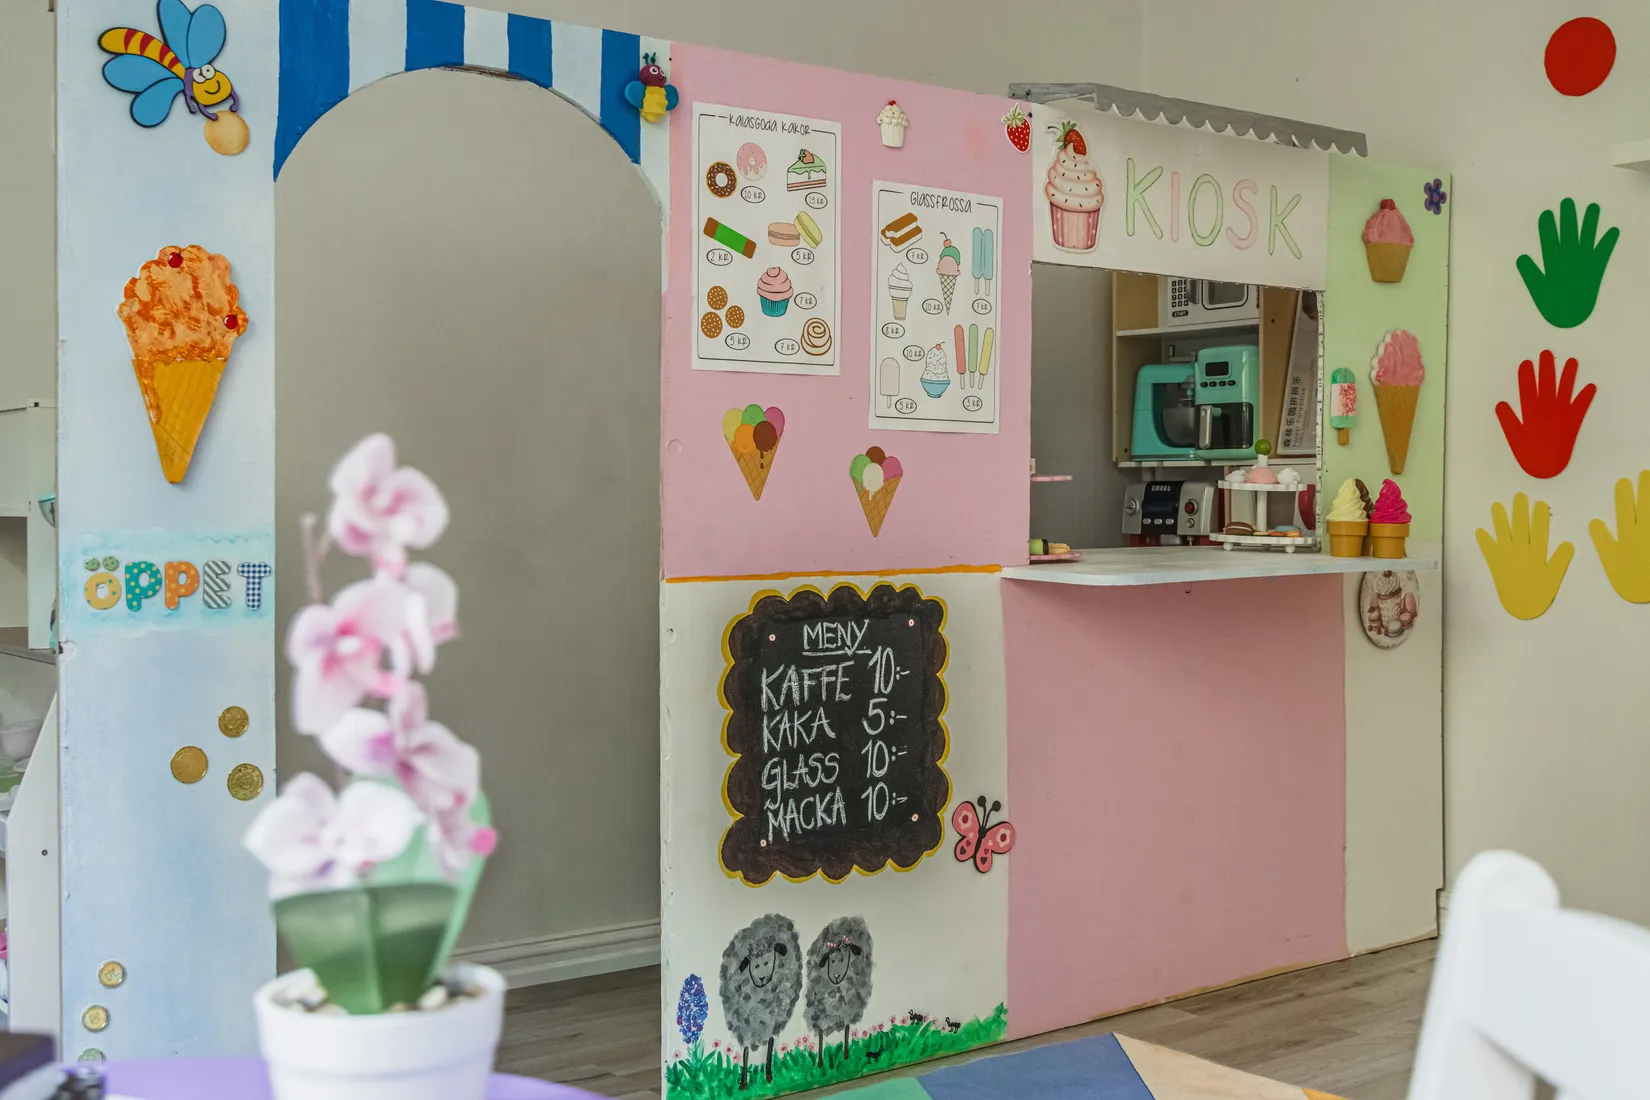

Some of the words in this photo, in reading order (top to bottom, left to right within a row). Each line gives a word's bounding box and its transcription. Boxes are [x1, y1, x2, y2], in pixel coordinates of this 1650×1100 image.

[744, 189, 752, 200] 10
[808, 196, 816, 205] 15
[1125, 157, 1302, 260] KIOSK
[710, 251, 716, 262] 2
[795, 251, 801, 261] 5
[910, 251, 915, 260] 7
[799, 296, 804, 305] 7
[925, 302, 932, 311] 10
[976, 302, 981, 311] 7
[729, 335, 736, 346] 5
[780, 342, 785, 352] 7
[906, 349, 913, 358] 10
[84, 556, 272, 612] ÖPPET
[803, 618, 870, 655] MENY
[761, 661, 855, 712] KAFFE
[867, 645, 910, 695] 10:-
[763, 706, 836, 753] KAKA
[862, 698, 907, 735] 5:-
[761, 752, 840, 802] GLASS
[765, 786, 847, 844] MACKA
